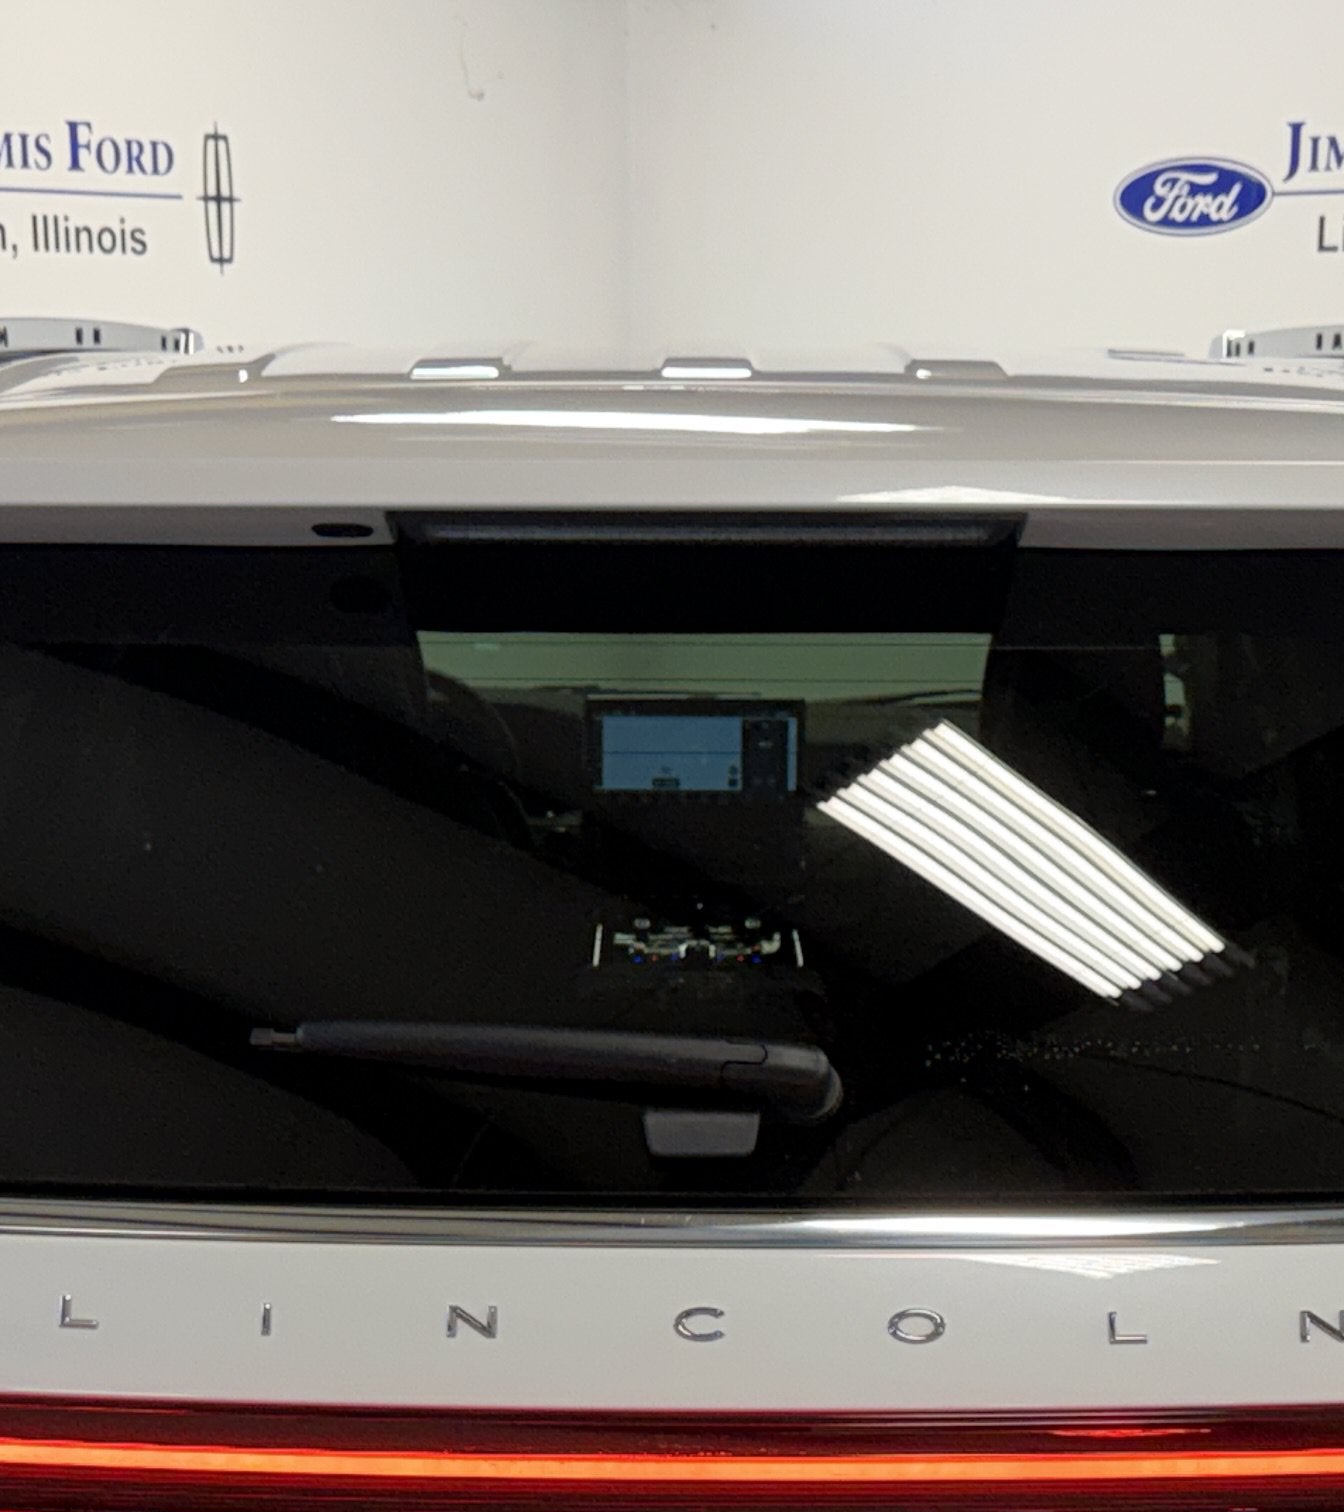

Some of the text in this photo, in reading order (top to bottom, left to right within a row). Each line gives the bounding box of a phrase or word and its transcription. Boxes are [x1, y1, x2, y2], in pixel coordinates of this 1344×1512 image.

[66, 120, 174, 177] FORD
[1143, 171, 1238, 223] Ford
[31, 213, 148, 256] Illinois
